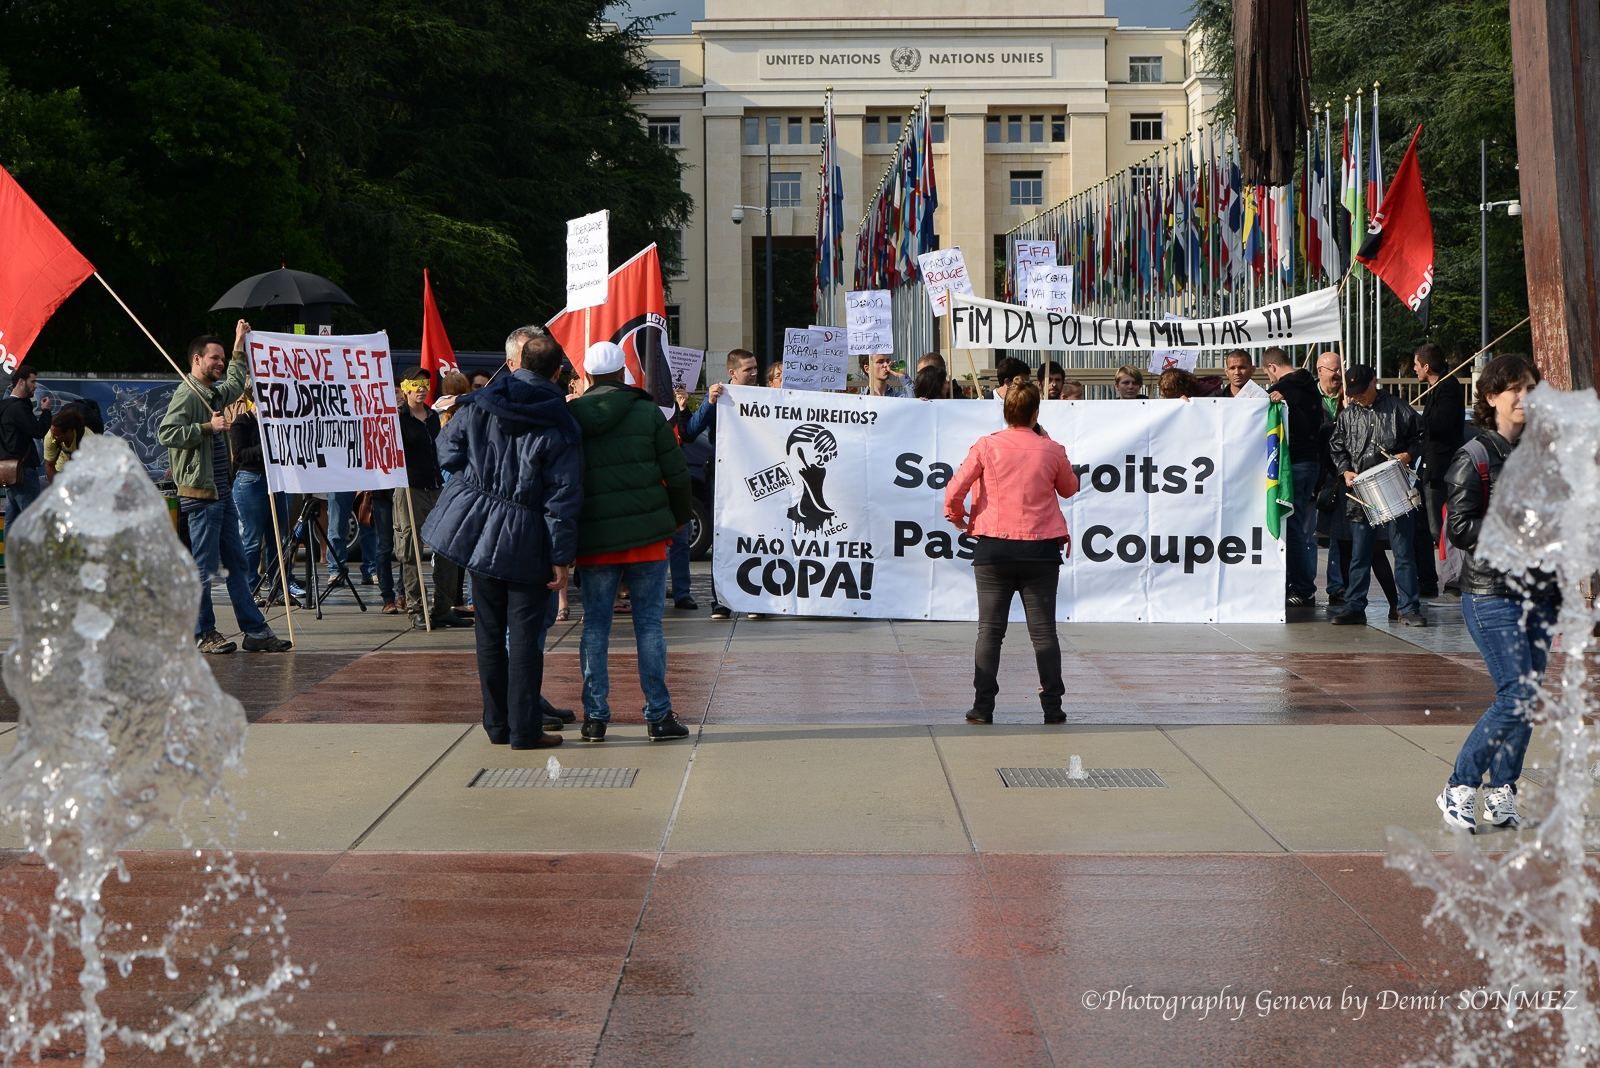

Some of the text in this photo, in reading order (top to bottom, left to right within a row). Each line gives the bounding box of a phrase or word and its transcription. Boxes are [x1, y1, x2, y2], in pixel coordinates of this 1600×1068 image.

[766, 54, 881, 65] UNITED NATIONS
[929, 52, 1044, 64] NATIONS UNIES
[1017, 244, 1051, 258] FIFA
[922, 255, 959, 271] CARTON
[925, 267, 964, 285] ROUGE
[1029, 272, 1043, 284] NA
[1050, 291, 1067, 300] TER
[1004, 309, 1037, 343] DA
[1047, 313, 1140, 347] POLÍCIA
[1150, 320, 1252, 347] MILITAR
[787, 332, 809, 344] VEM
[250, 342, 387, 381] GENEVE EST
[784, 360, 799, 370] DE
[256, 380, 396, 418] SOLIDAIRE AVEC
[740, 401, 878, 425] NÃO TEM DIREITOS?
[347, 420, 362, 468] AU
[815, 451, 838, 466] 2014
[748, 466, 788, 492] FIFA
[893, 452, 1215, 494] Sa roits?
[754, 477, 792, 498] GO HOME
[824, 522, 848, 537] RECC
[736, 534, 874, 559] NÃO VAI TER
[893, 520, 978, 560] Pas
[1081, 525, 1263, 574] Coupe!
[736, 557, 875, 601] COPA!
